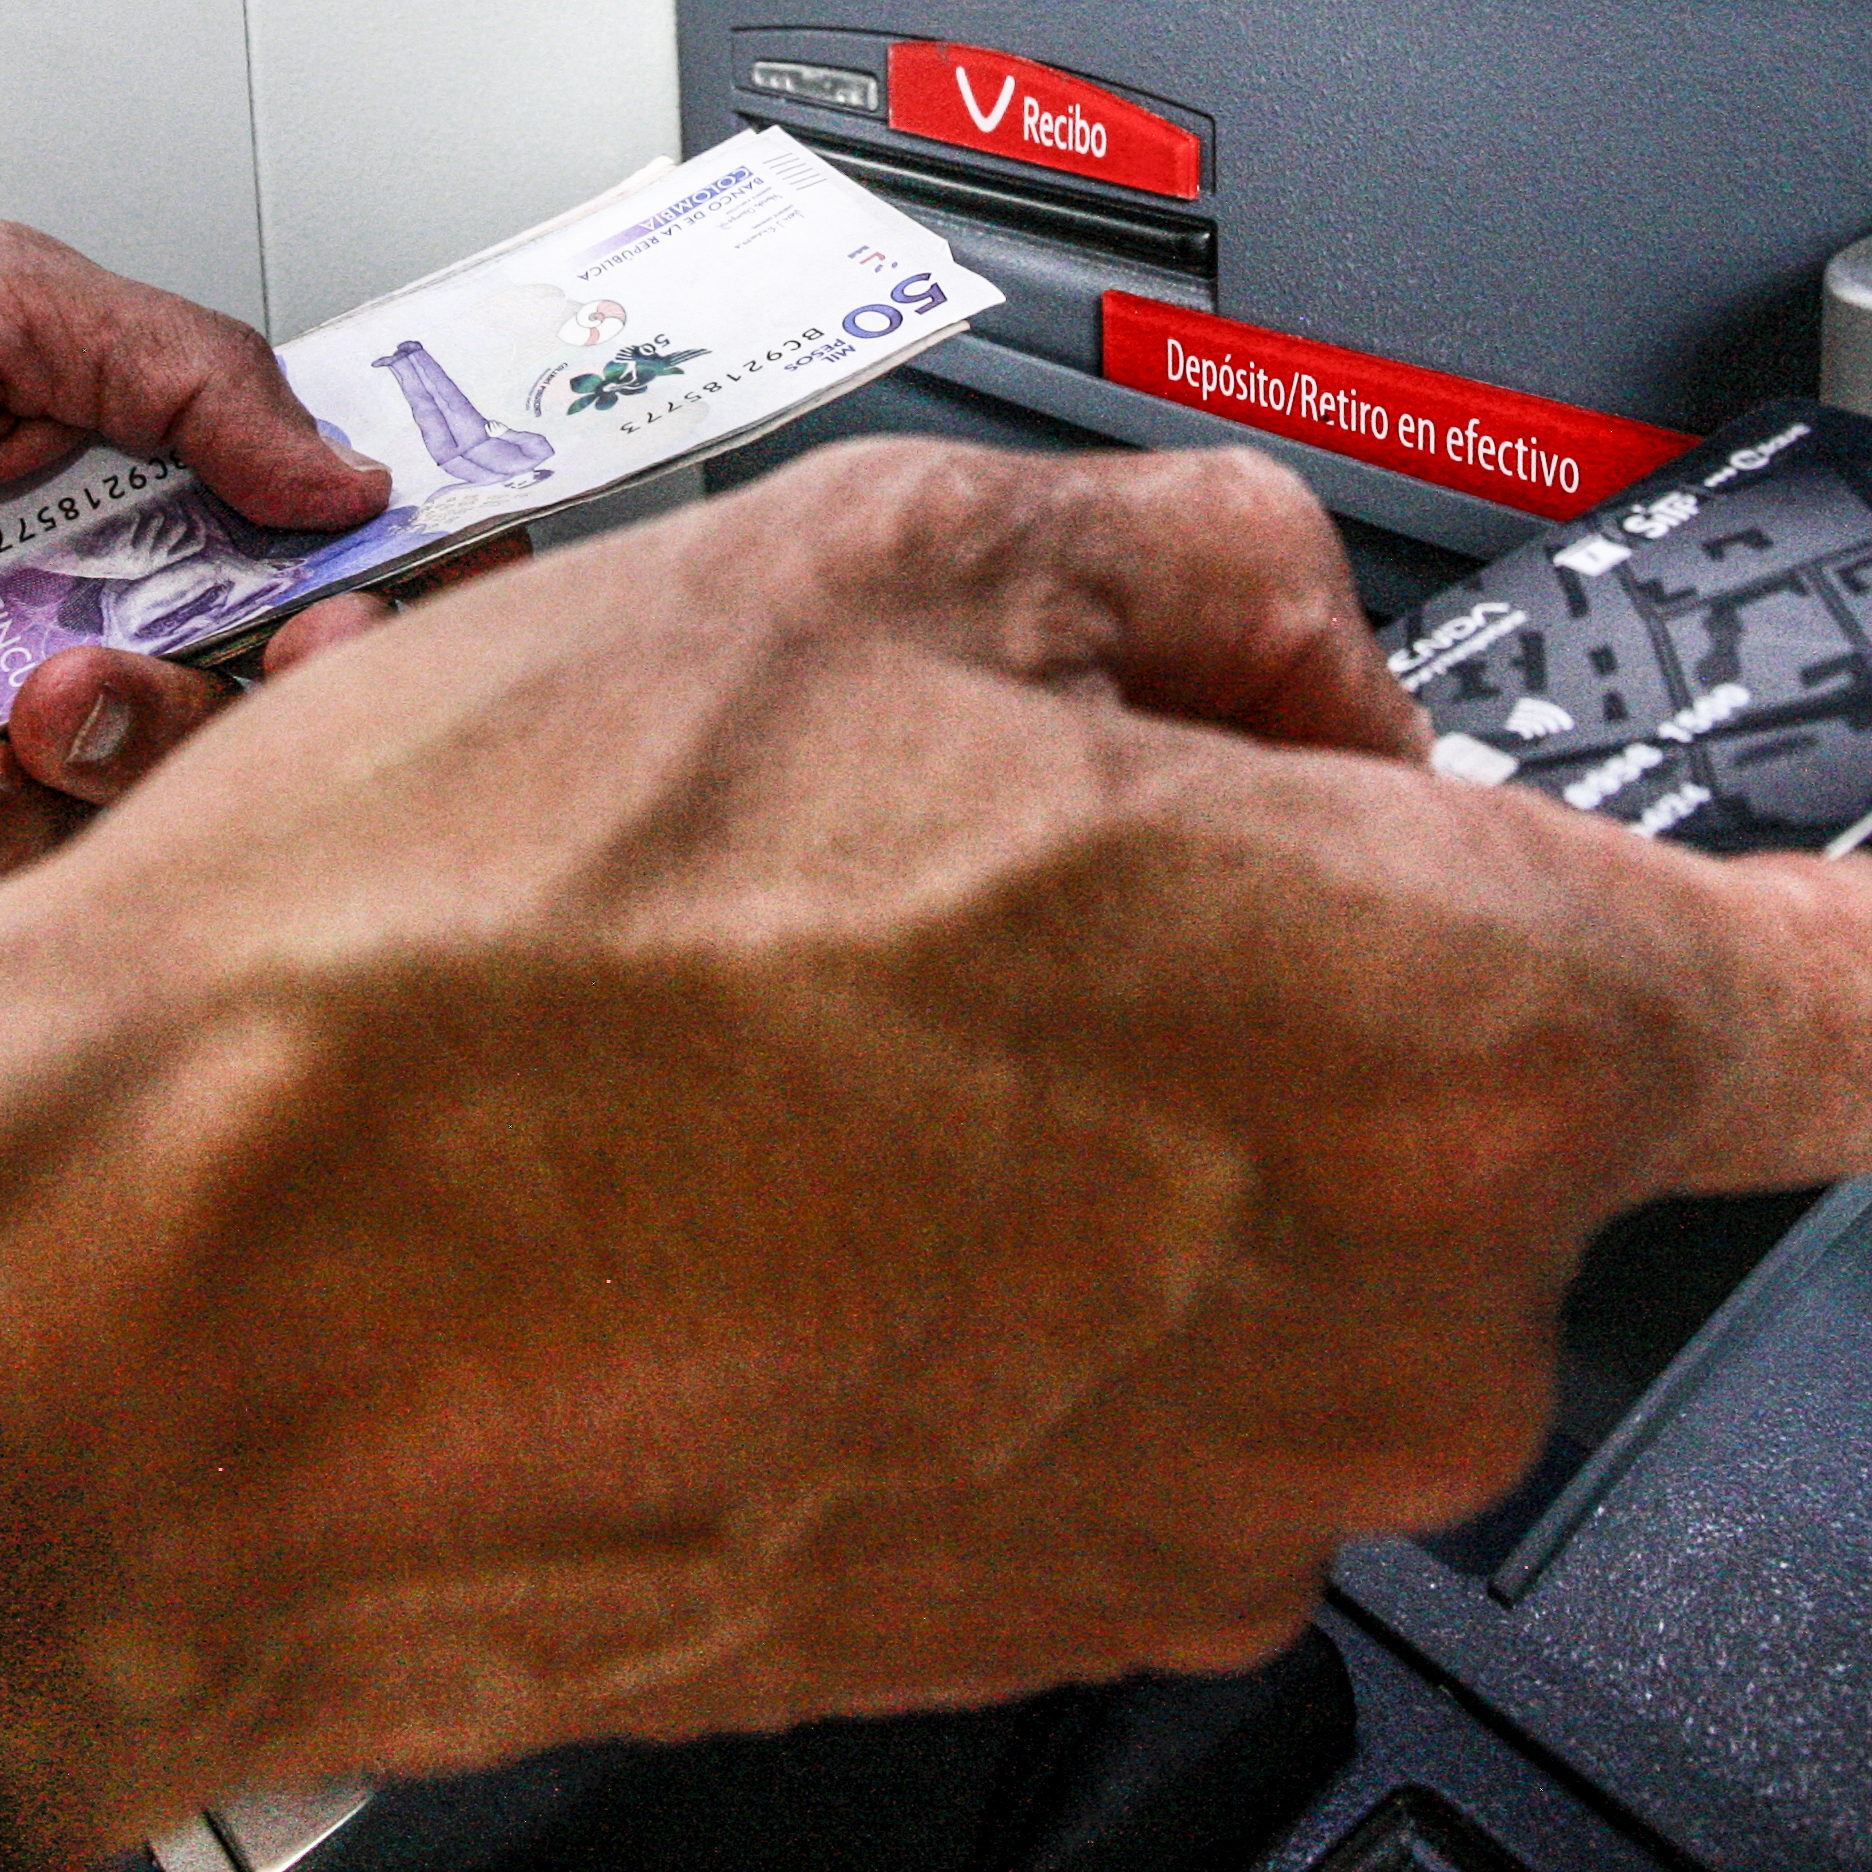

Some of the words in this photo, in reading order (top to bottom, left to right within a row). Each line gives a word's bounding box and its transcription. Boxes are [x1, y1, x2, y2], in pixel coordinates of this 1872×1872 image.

[1023, 95, 1108, 159] Recibo
[639, 166, 753, 231] COLOMBIA
[708, 175, 765, 212] BANCO
[660, 223, 684, 237] LA
[682, 210, 707, 227] DE
[576, 234, 661, 282] REPÚBLICA
[841, 272, 948, 339] 50
[638, 332, 671, 357] 50
[783, 338, 846, 373] PESOS
[820, 343, 857, 364] MIL
[619, 326, 826, 435] BC92185773
[1166, 337, 1389, 441] Depósito/Retiro
[1397, 412, 1437, 455] en
[1445, 417, 1581, 494] efectivo
